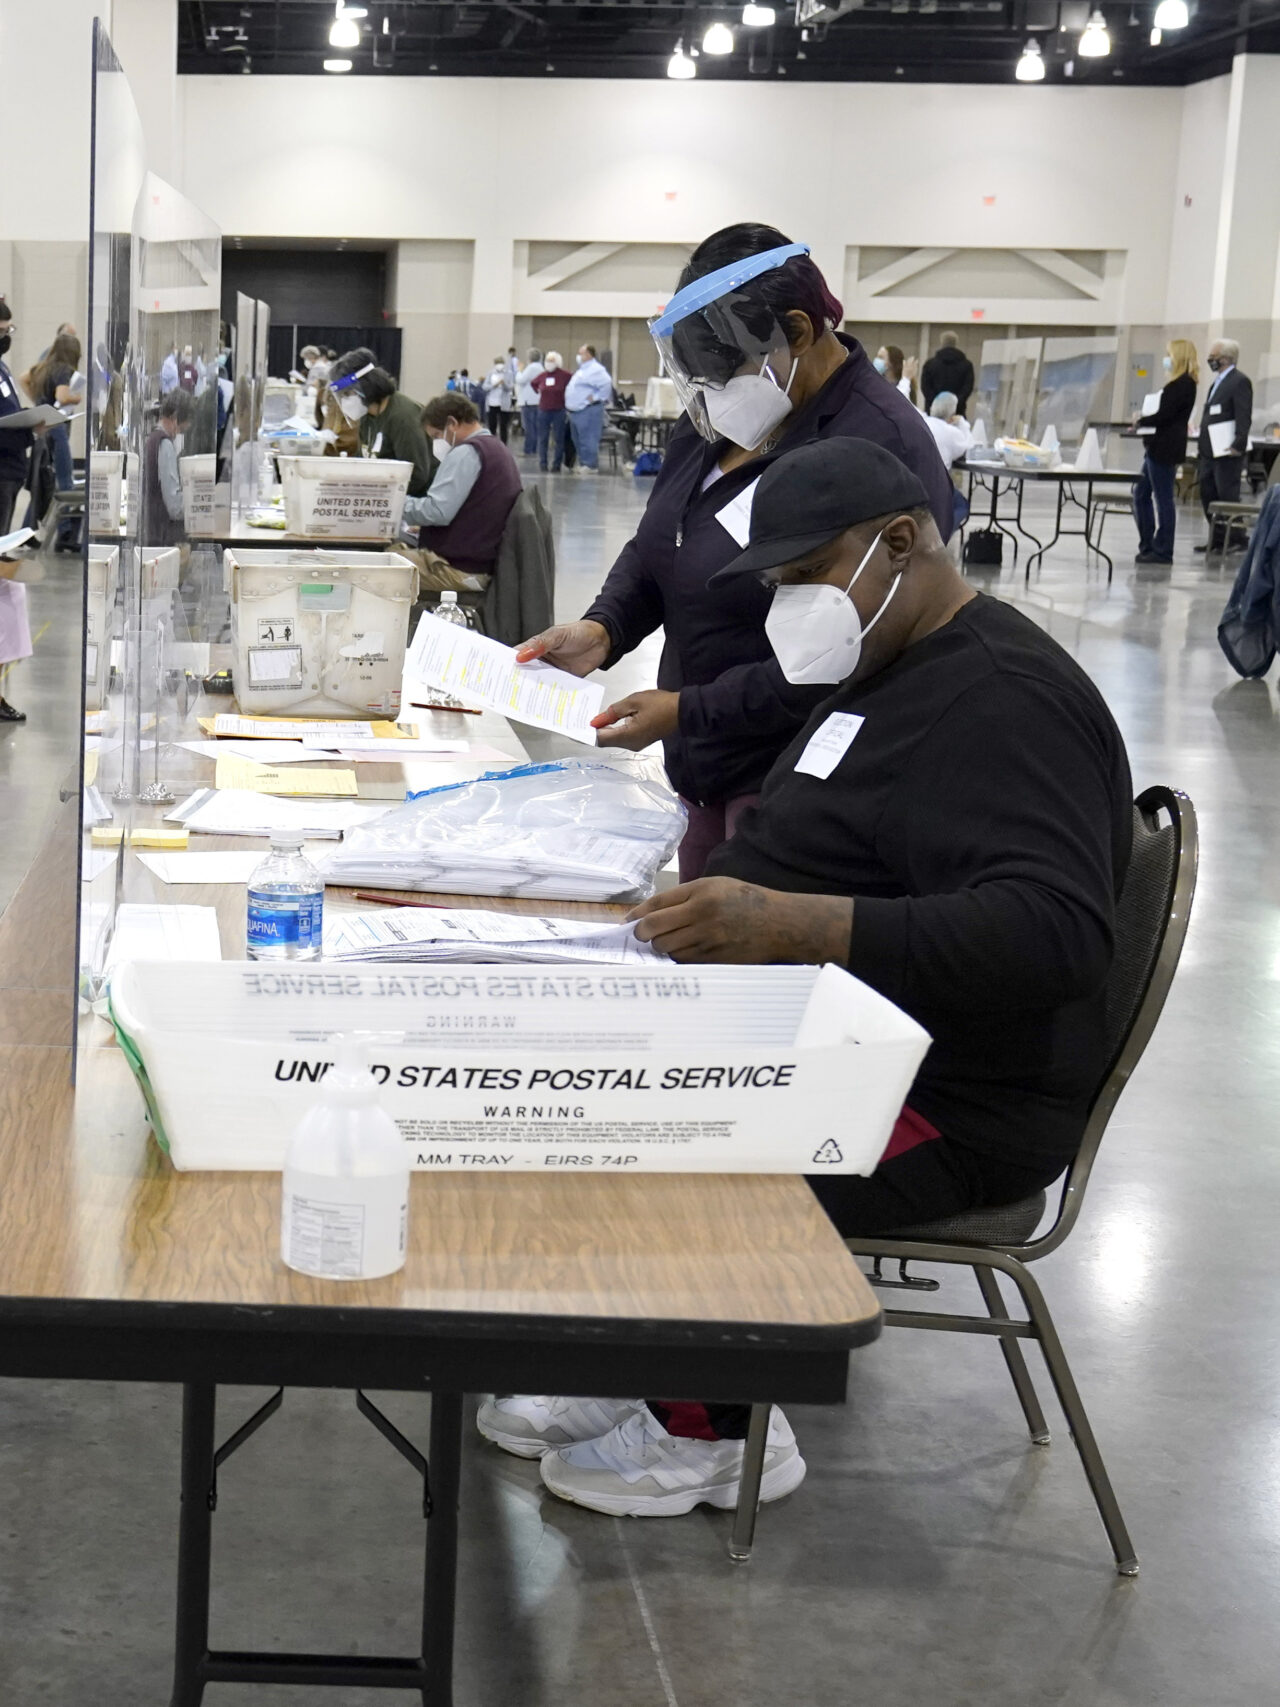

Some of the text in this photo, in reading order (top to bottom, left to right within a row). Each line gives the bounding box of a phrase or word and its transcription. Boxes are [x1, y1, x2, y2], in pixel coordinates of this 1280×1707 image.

[317, 498, 389, 508] UNITED STATES
[313, 508, 392, 518] POSTAL SERVICE
[275, 1059, 797, 1091] UNID STATES POSTAL SERVICE
[483, 1105, 585, 1119] WARNING
[416, 1153, 451, 1165] MM
[459, 1153, 514, 1165] TRAY
[544, 1154, 593, 1166] EIRS
[601, 1154, 638, 1166] 74P
